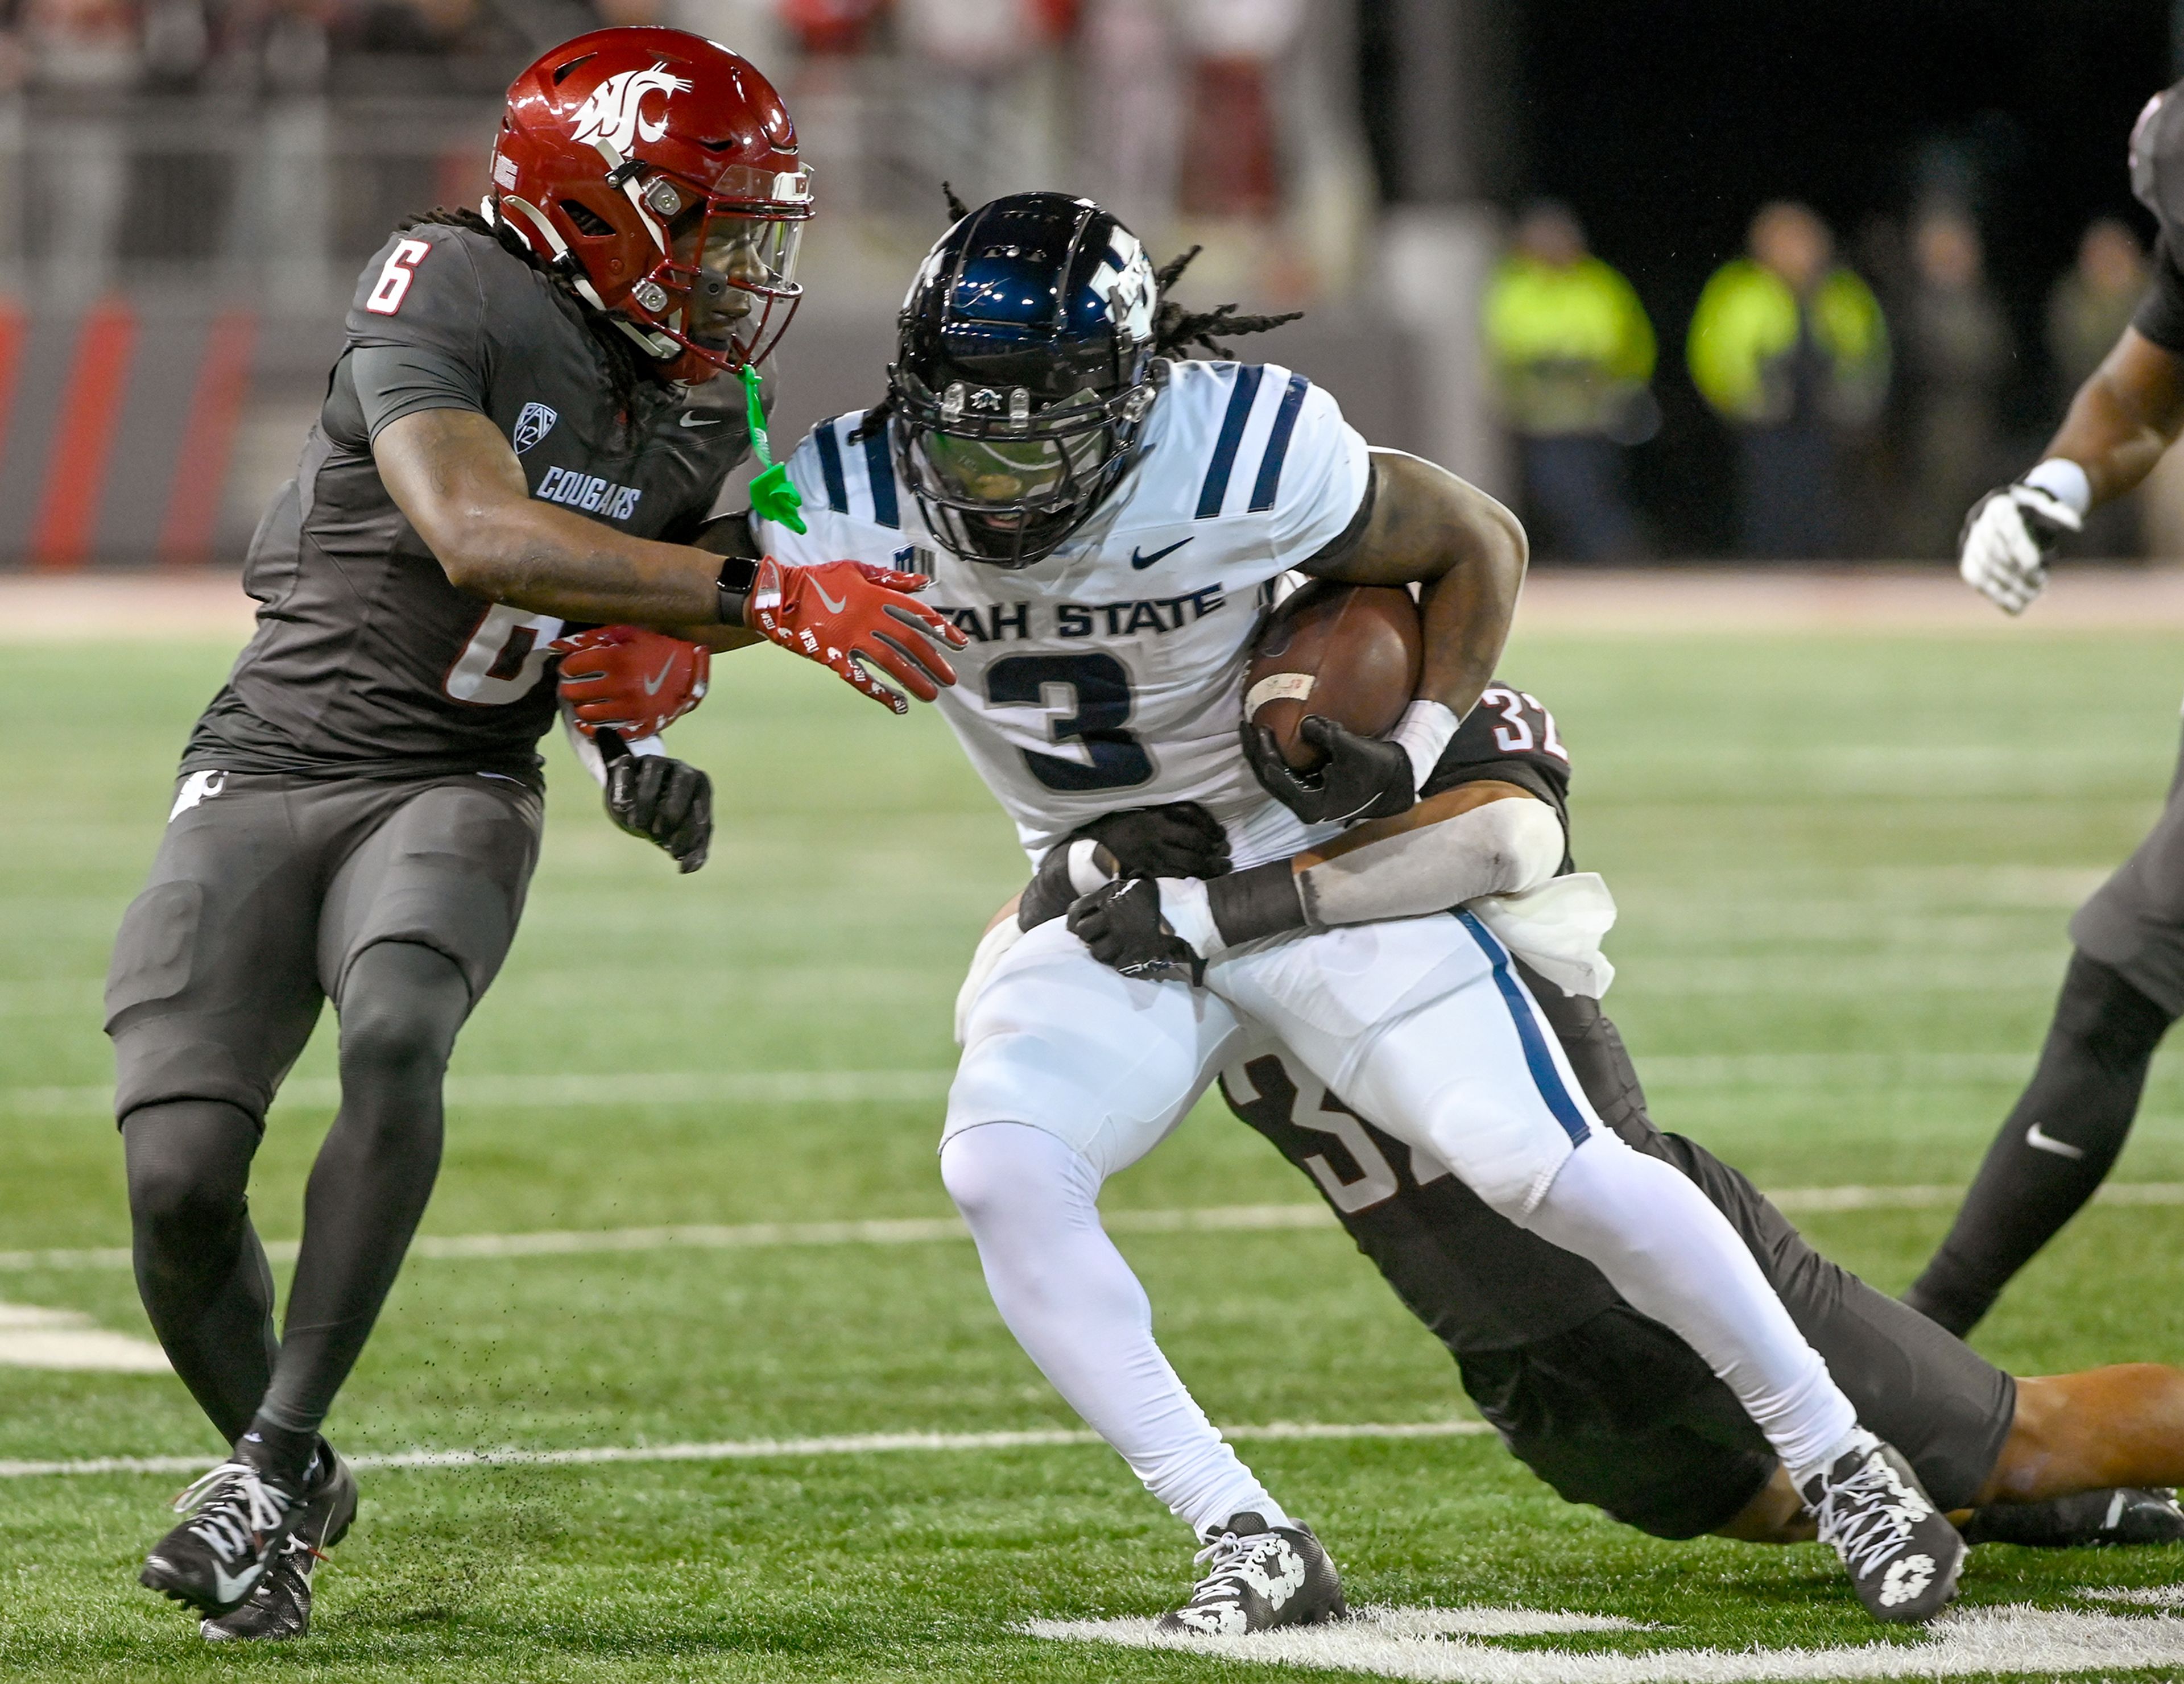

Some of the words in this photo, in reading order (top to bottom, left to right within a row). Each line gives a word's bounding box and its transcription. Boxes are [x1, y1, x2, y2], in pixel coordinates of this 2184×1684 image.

[366, 238, 432, 316] 6
[516, 425, 539, 445] 12
[518, 405, 556, 438] PAC
[536, 465, 642, 520] COUGARS
[760, 610, 776, 630] WSU
[931, 601, 1031, 643] AH
[1056, 581, 1227, 638] STATE
[799, 627, 820, 653] WSU
[892, 695, 908, 713] SU
[979, 648, 1160, 796] 3
[1221, 1035, 1451, 1214] 3
